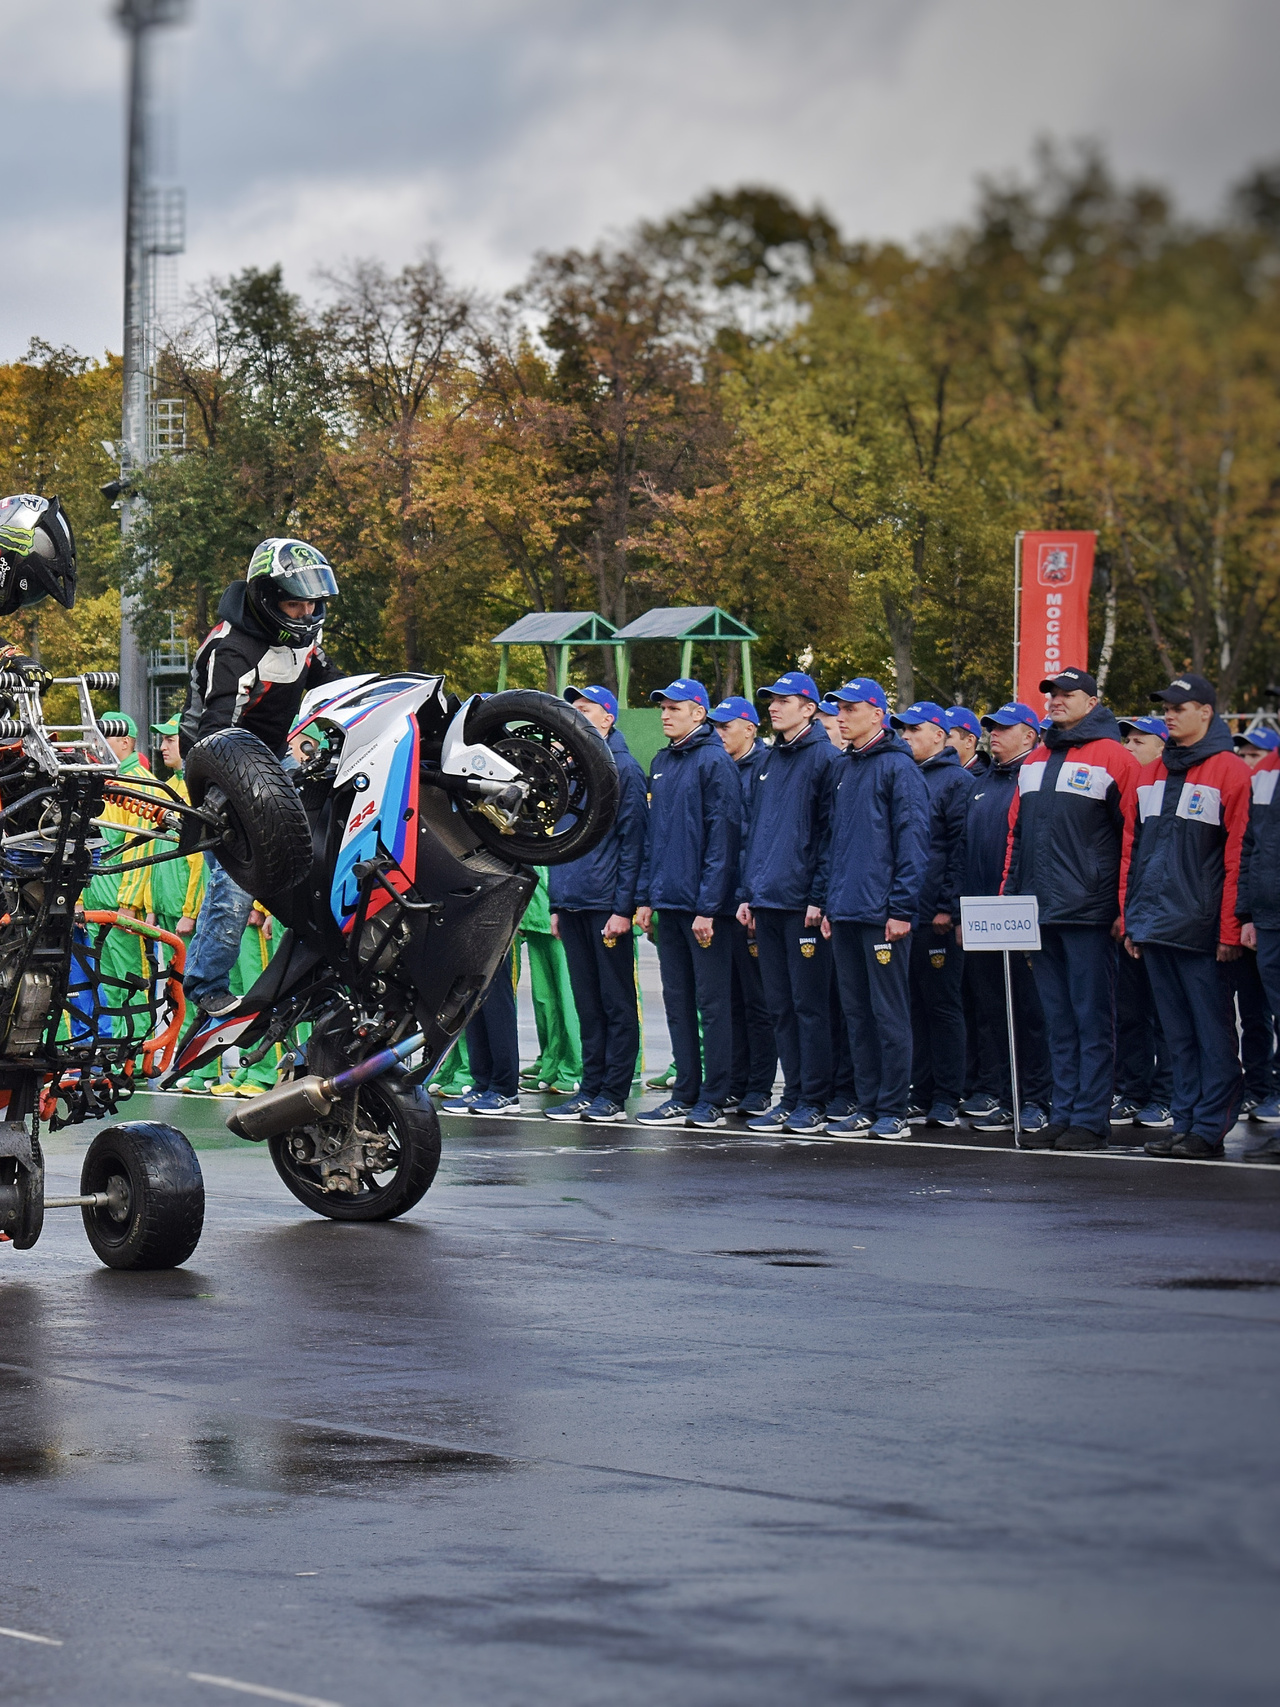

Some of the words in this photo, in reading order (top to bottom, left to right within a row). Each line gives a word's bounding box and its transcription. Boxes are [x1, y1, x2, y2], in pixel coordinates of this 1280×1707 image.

[349, 800, 377, 833] RR
[968, 920, 988, 933] УВД
[990, 922, 1002, 931] по
[1004, 919, 1032, 931] СЗАО
